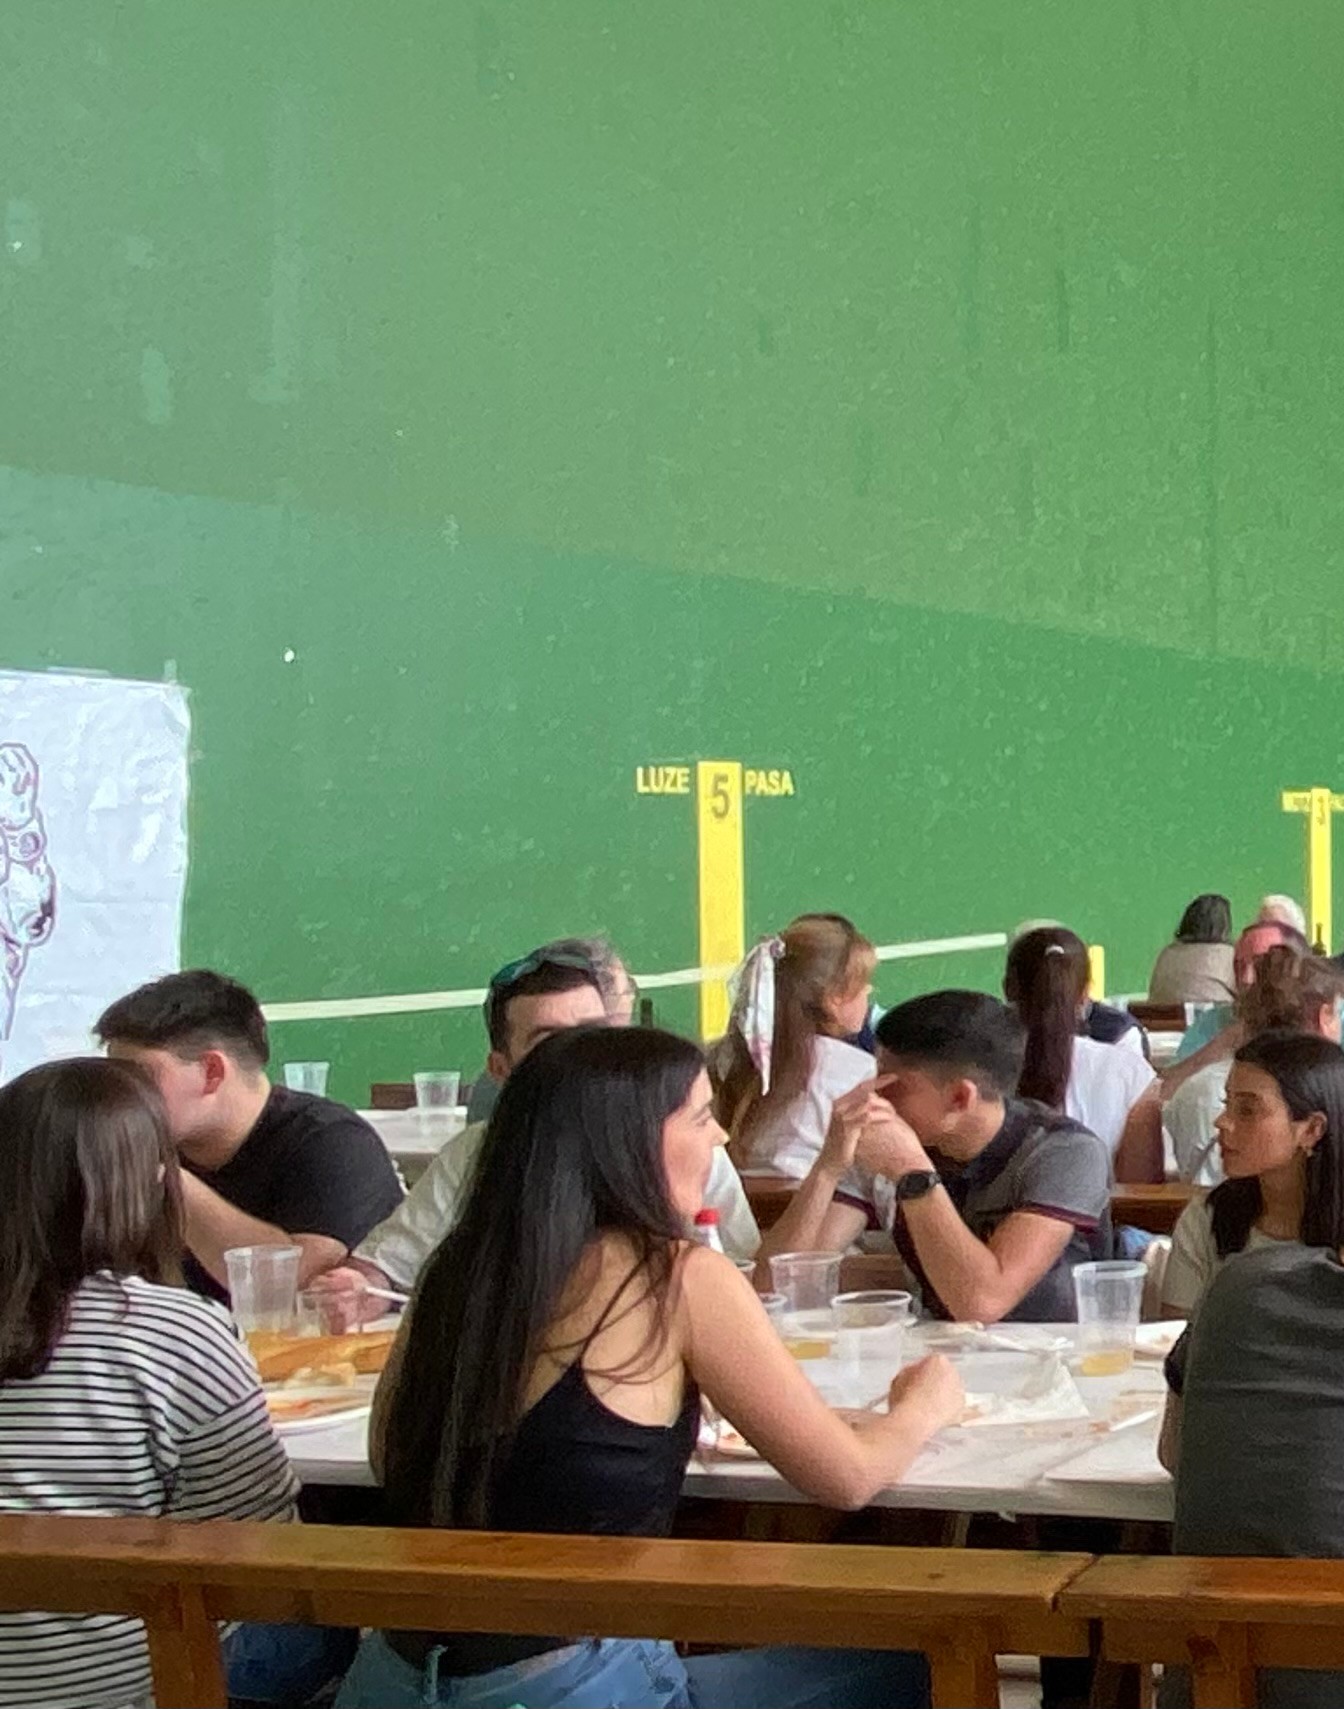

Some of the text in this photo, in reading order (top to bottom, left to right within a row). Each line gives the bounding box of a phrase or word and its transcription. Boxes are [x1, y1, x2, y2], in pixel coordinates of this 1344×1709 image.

[636, 766, 795, 820] LUZE 5 PASA
